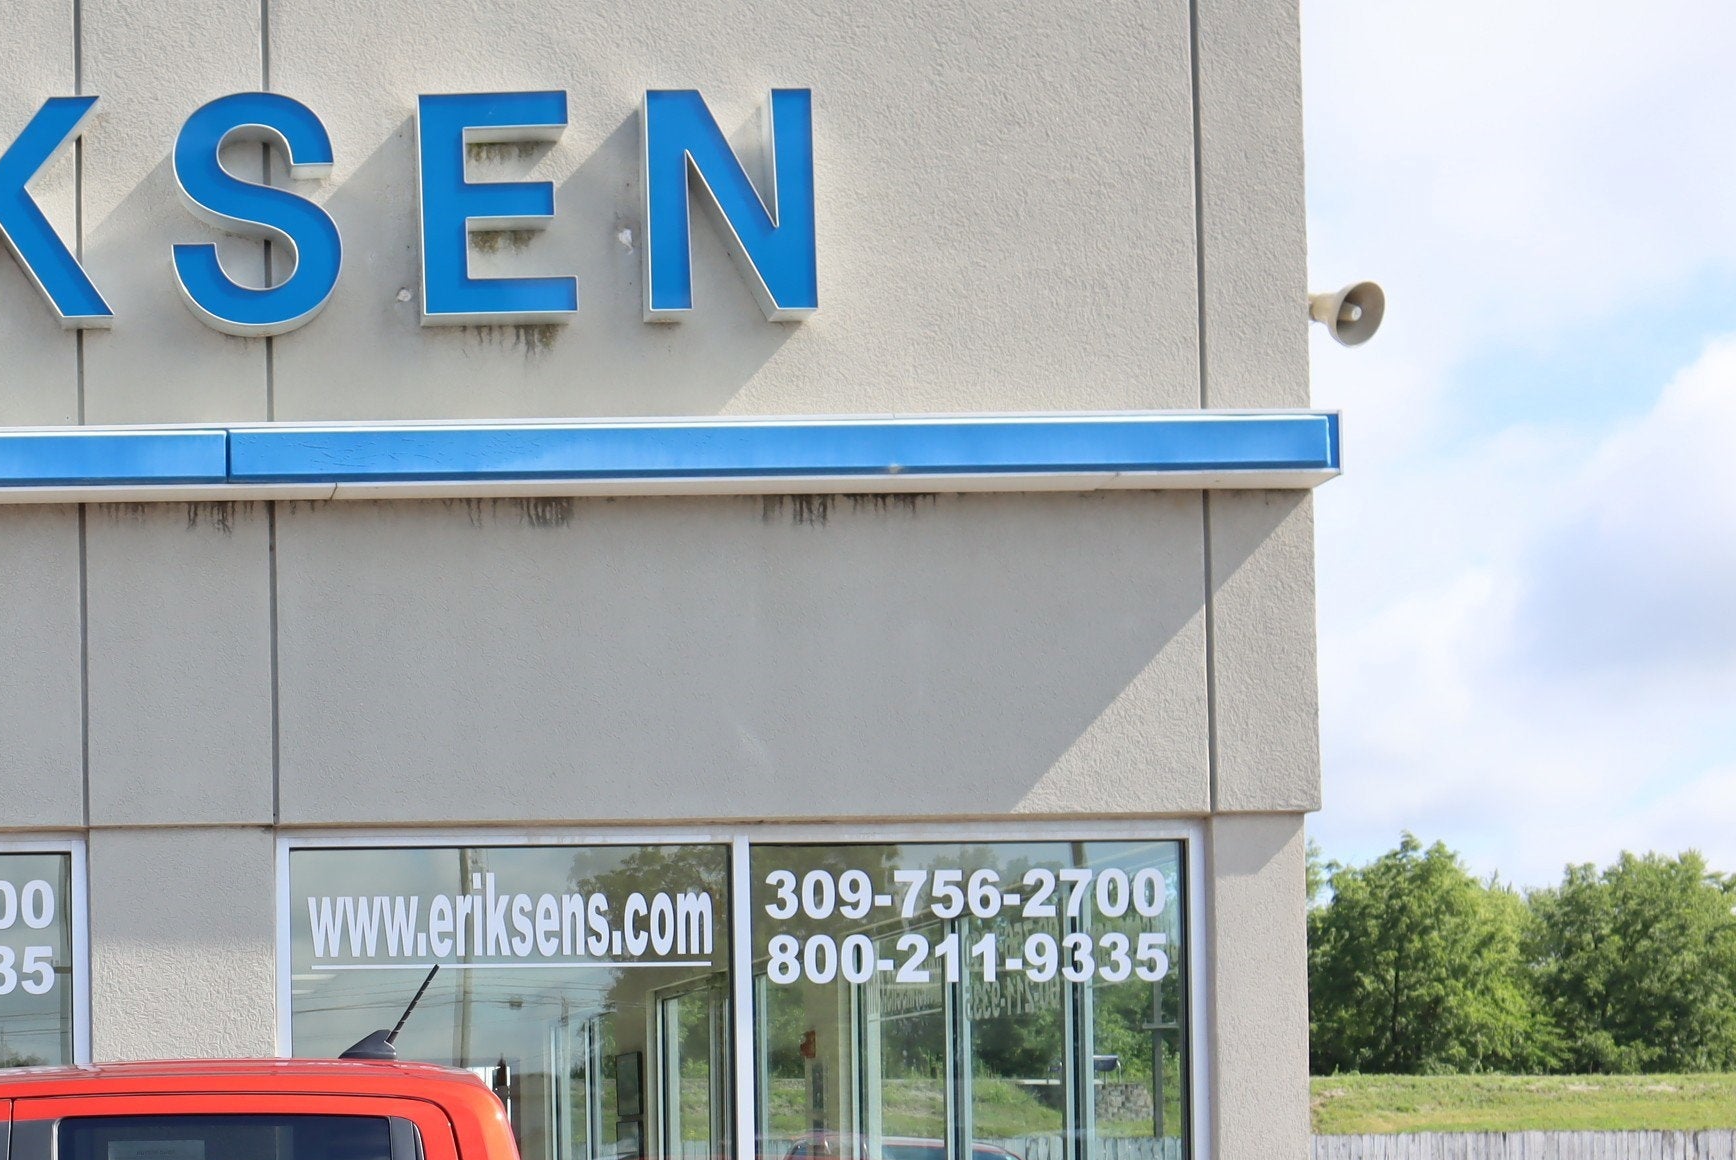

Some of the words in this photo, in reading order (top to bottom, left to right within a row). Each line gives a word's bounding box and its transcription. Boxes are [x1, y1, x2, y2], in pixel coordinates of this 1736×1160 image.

[306, 871, 713, 959] www.eriksens.com
[764, 867, 1166, 920] 309-756-2700
[766, 932, 1169, 985] 800-211-9335
